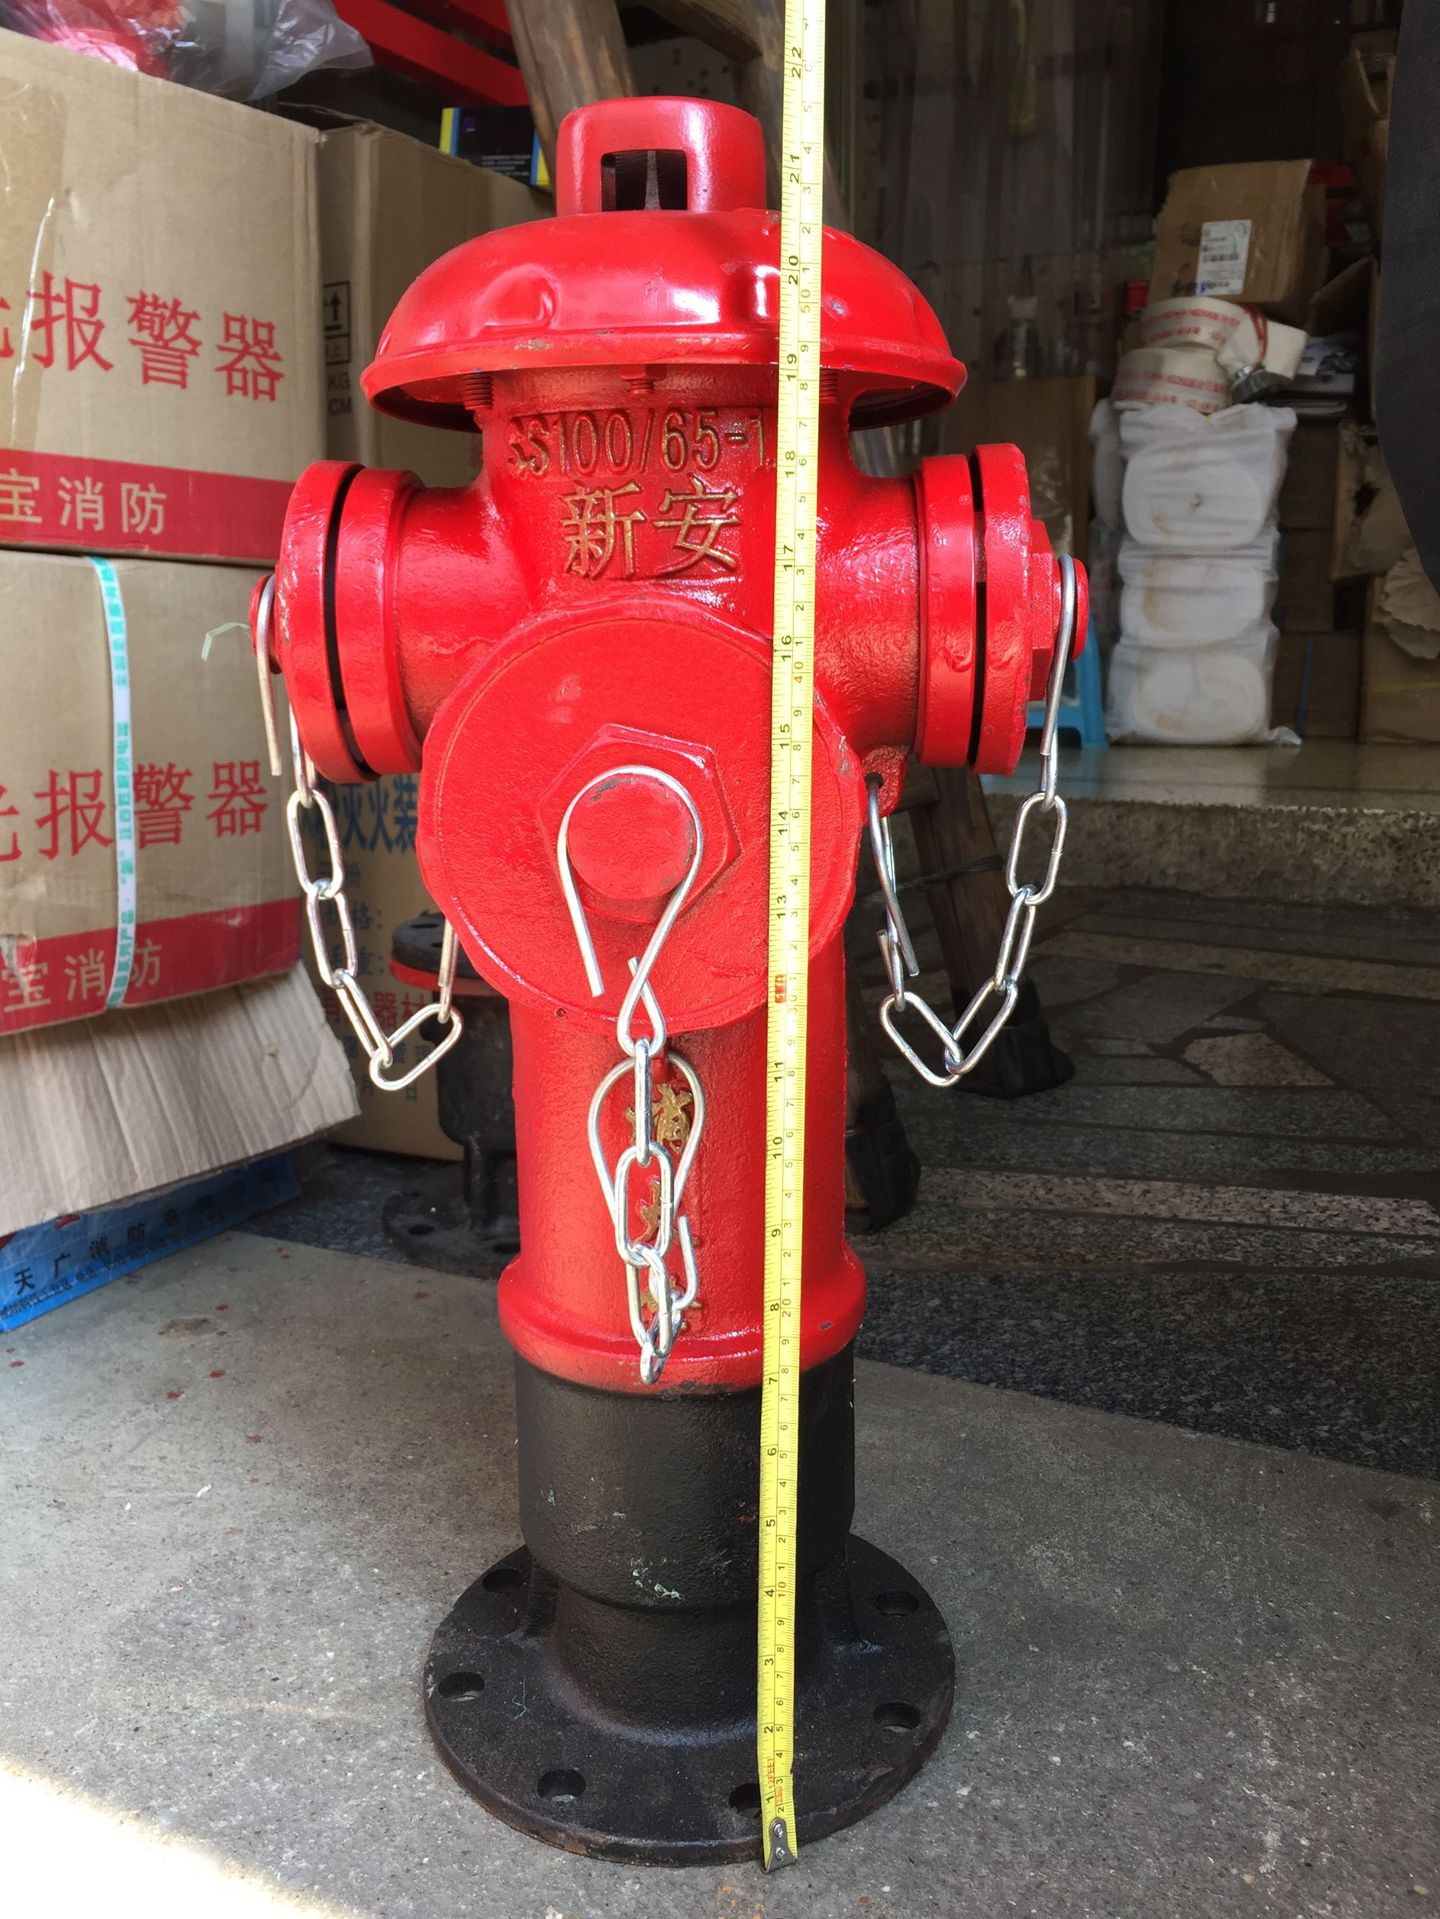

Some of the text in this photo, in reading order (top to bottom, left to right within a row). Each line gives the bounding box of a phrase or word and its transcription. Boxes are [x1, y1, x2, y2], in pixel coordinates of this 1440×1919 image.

[791, 46, 802, 80] 22
[789, 153, 800, 184] 21
[788, 255, 799, 286] 20
[800, 289, 811, 314] 50
[786, 353, 797, 382] 19
[785, 450, 796, 479] 18
[560, 473, 742, 580] 新安
[783, 544, 794, 572] 17
[781, 635, 792, 662] 16
[793, 661, 804, 684] 40
[779, 723, 790, 750] 15
[778, 810, 789, 836] 14
[776, 894, 787, 920] 13
[774, 1061, 784, 1083] 11
[772, 1136, 783, 1159] 10
[771, 1228, 781, 1238] 9
[770, 1303, 780, 1312] 8
[782, 1298, 792, 1318] 20
[768, 1377, 778, 1385] 7
[767, 1447, 777, 1456] 6
[765, 1519, 776, 1527] 5
[765, 1589, 775, 1598] 4
[778, 1581, 787, 1598] 10
[764, 1658, 775, 1666] 3
[763, 1726, 774, 1734] 2
[766, 1795, 774, 1803] 1
